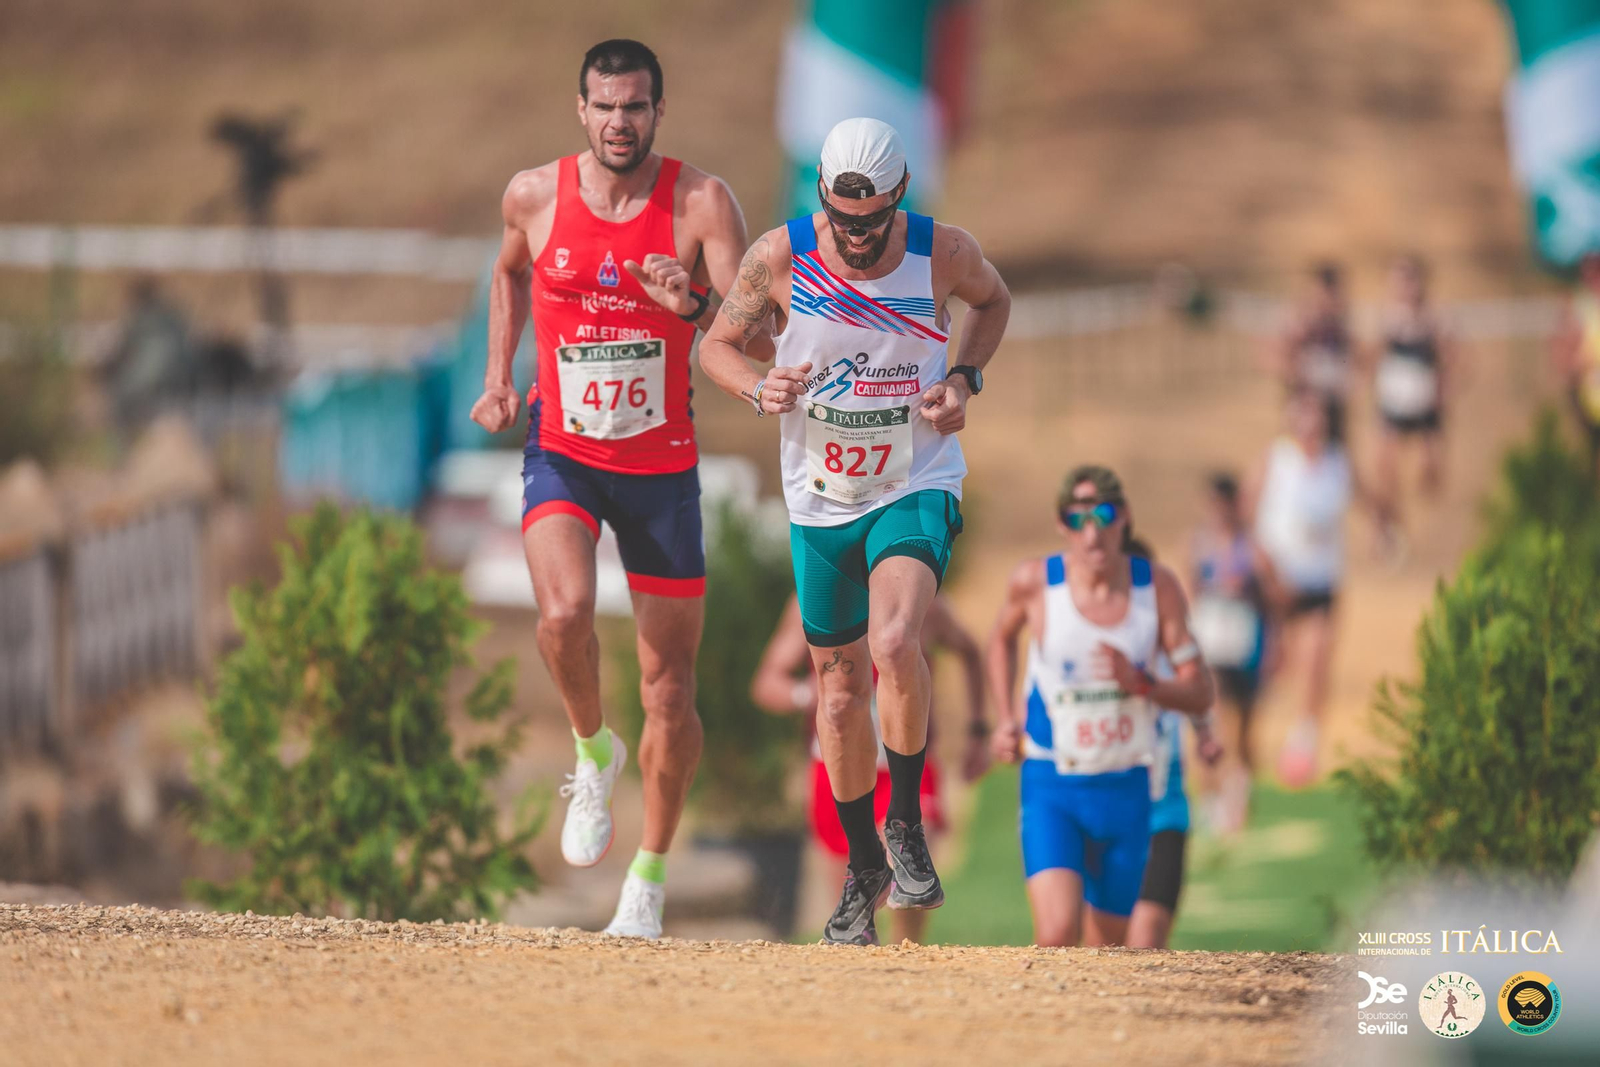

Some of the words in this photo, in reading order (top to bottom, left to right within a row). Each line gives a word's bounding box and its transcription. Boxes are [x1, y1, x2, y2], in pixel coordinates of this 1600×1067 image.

[576, 324, 651, 340] ATLETISMO
[586, 346, 638, 360] ITÁLICA
[582, 376, 648, 412] 476
[833, 411, 883, 426] ITÁLICA
[824, 441, 893, 478] 827
[1076, 715, 1134, 749] 850
